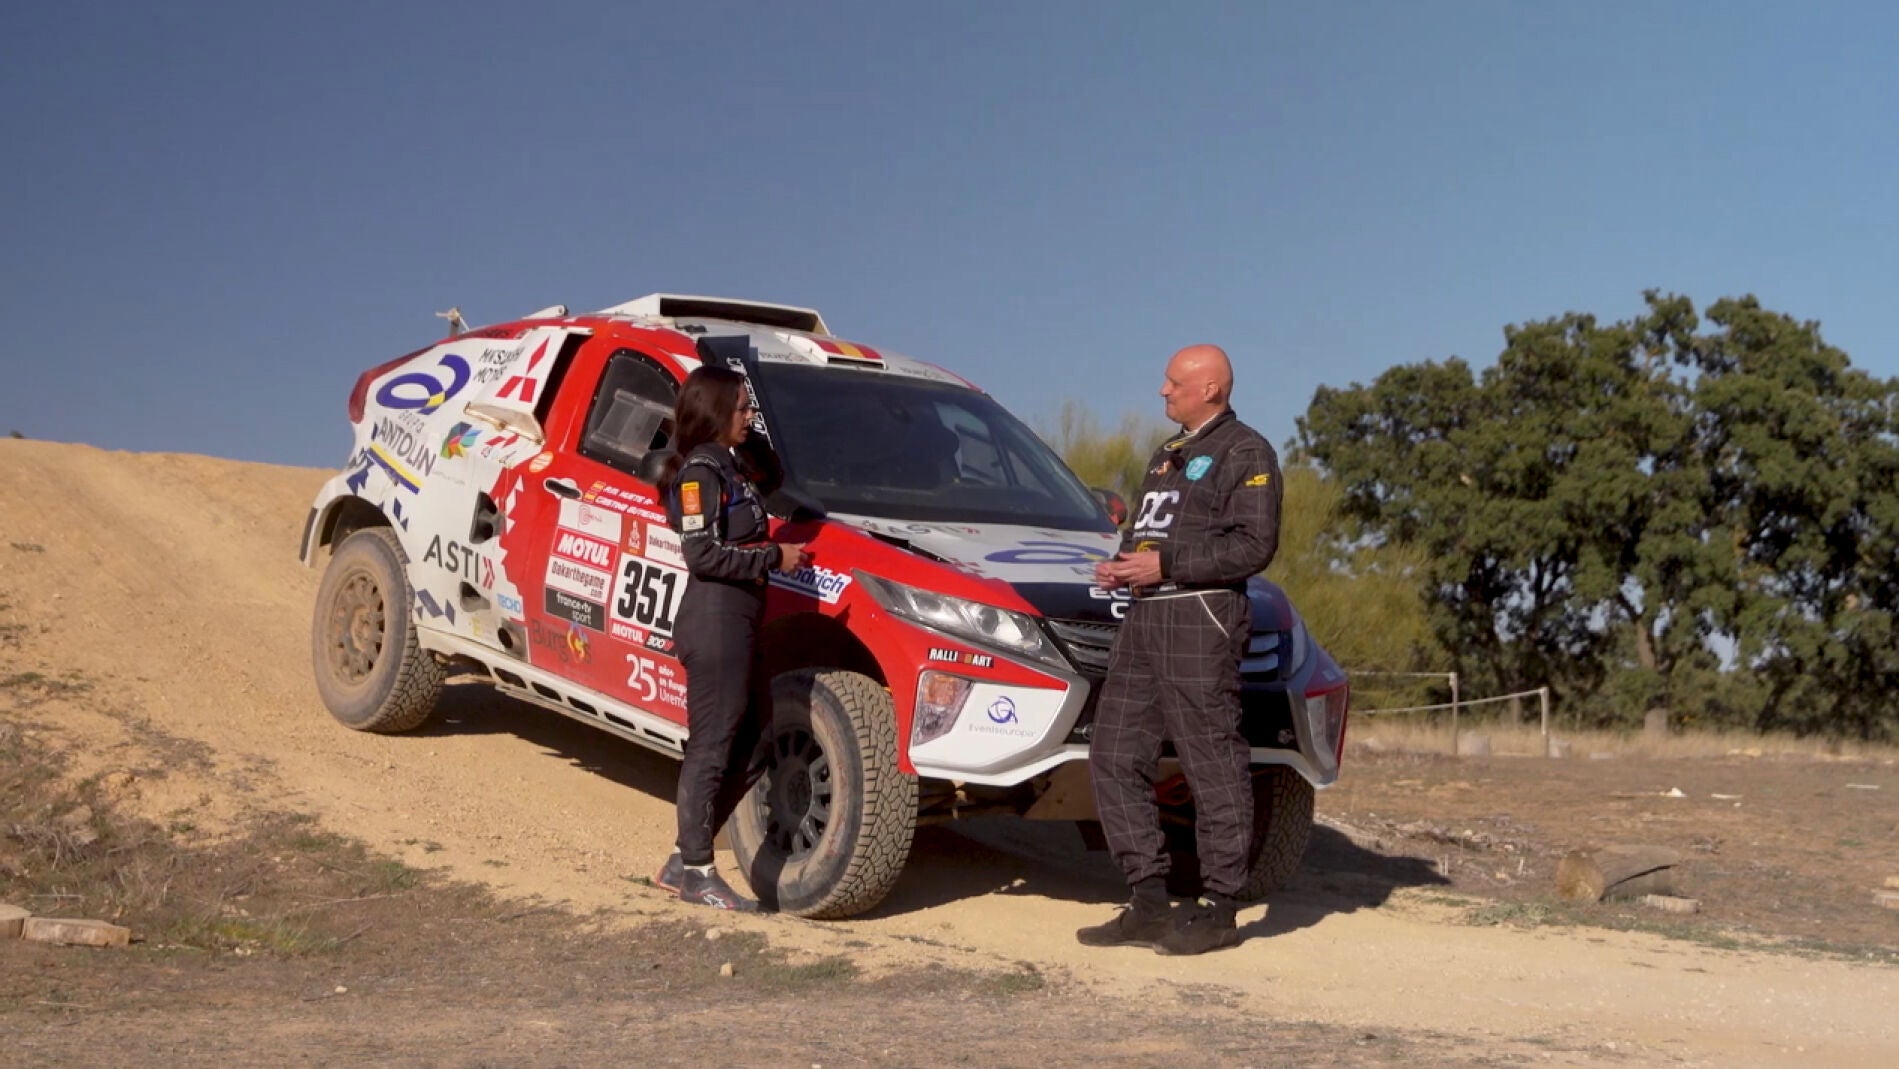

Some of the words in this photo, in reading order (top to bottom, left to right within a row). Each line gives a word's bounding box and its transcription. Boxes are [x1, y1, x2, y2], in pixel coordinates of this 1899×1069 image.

[379, 416, 437, 477] ANTOLIN
[423, 533, 480, 583] ASTI
[557, 533, 610, 566] MOTUL
[551, 560, 605, 589] Dakarthegame
[617, 560, 677, 631] 351
[572, 611, 592, 625] sport
[611, 622, 644, 643] MOTUL
[929, 648, 959, 662] RALLI
[625, 653, 658, 702] 25
